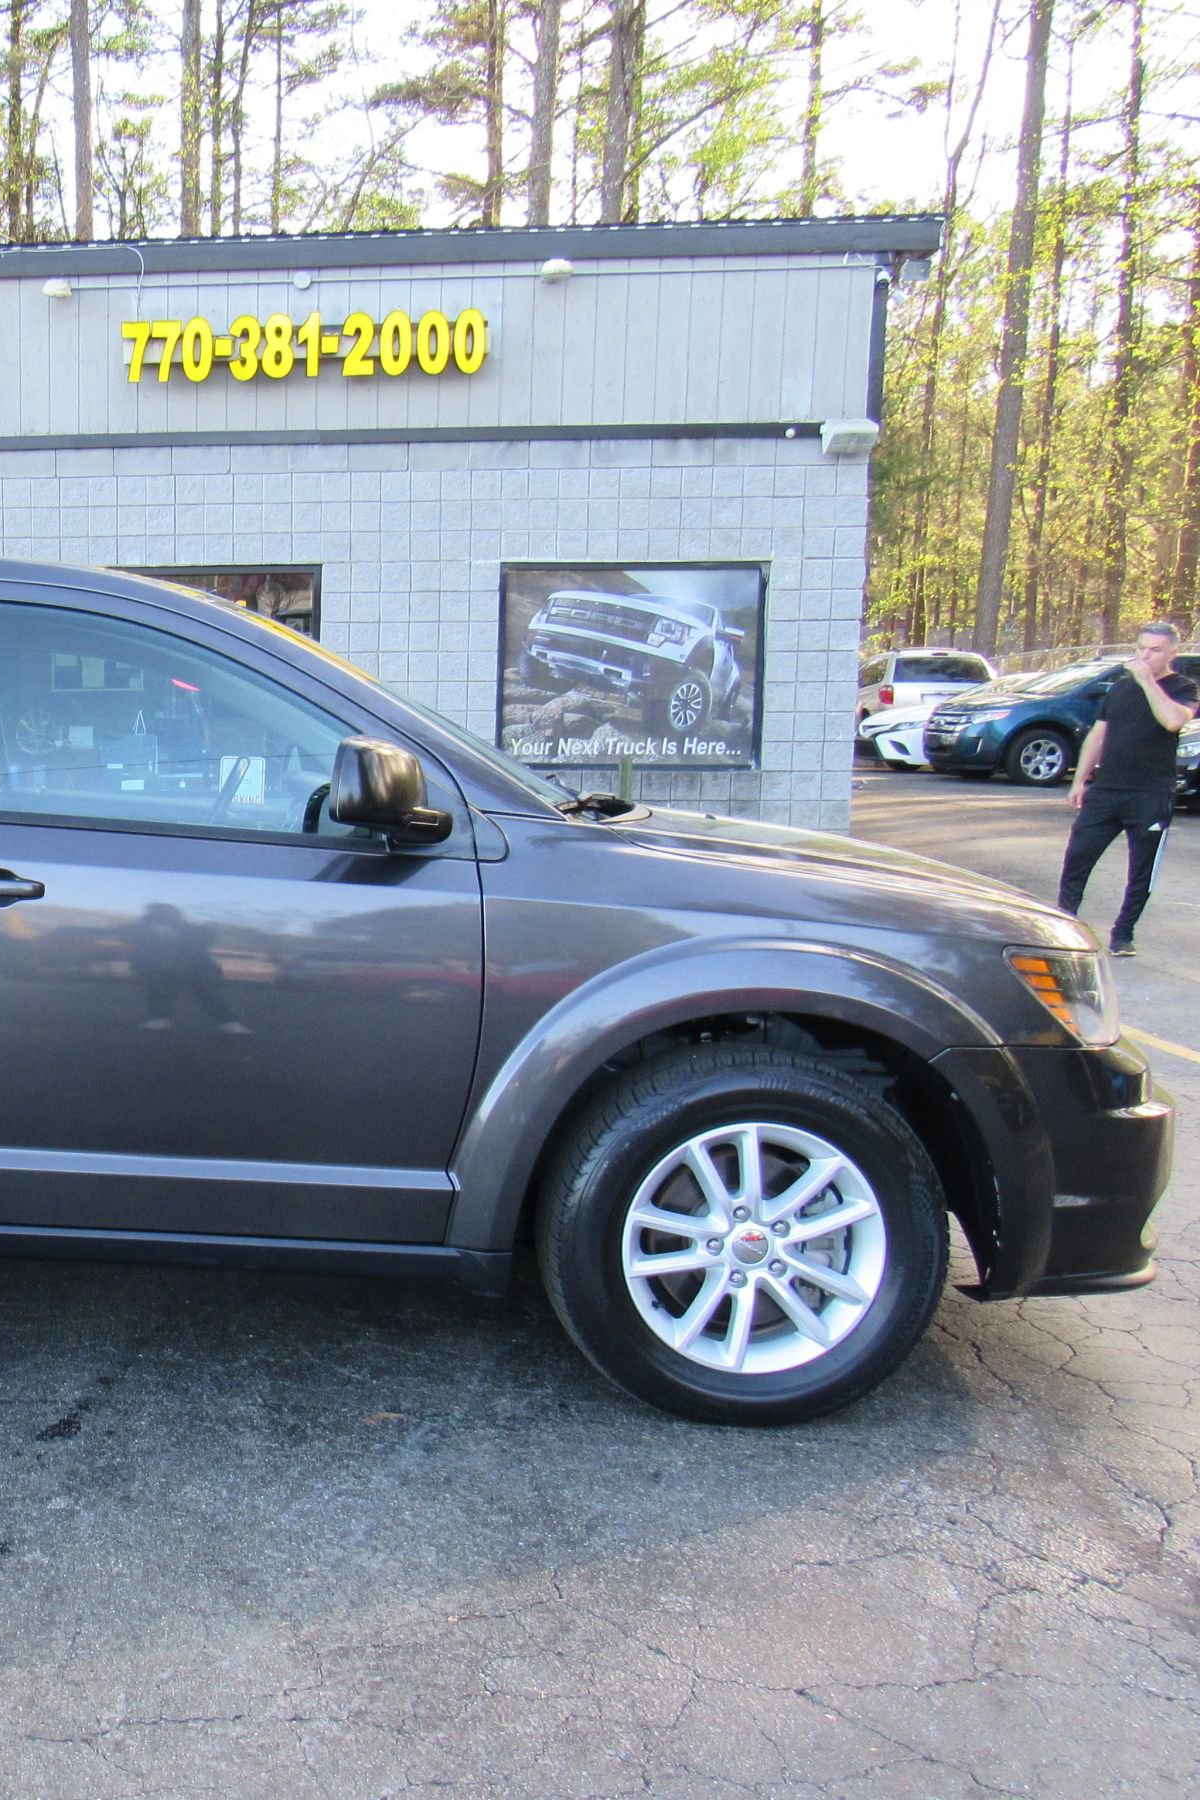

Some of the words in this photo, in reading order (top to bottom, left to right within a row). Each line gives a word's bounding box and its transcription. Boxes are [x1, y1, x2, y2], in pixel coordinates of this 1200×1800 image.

[121, 308, 488, 384] 770-381-2000
[510, 738, 552, 756] Your
[557, 738, 600, 755] Next
[606, 737, 657, 755] Truck
[661, 737, 677, 754] Is
[683, 737, 742, 755] Here...
